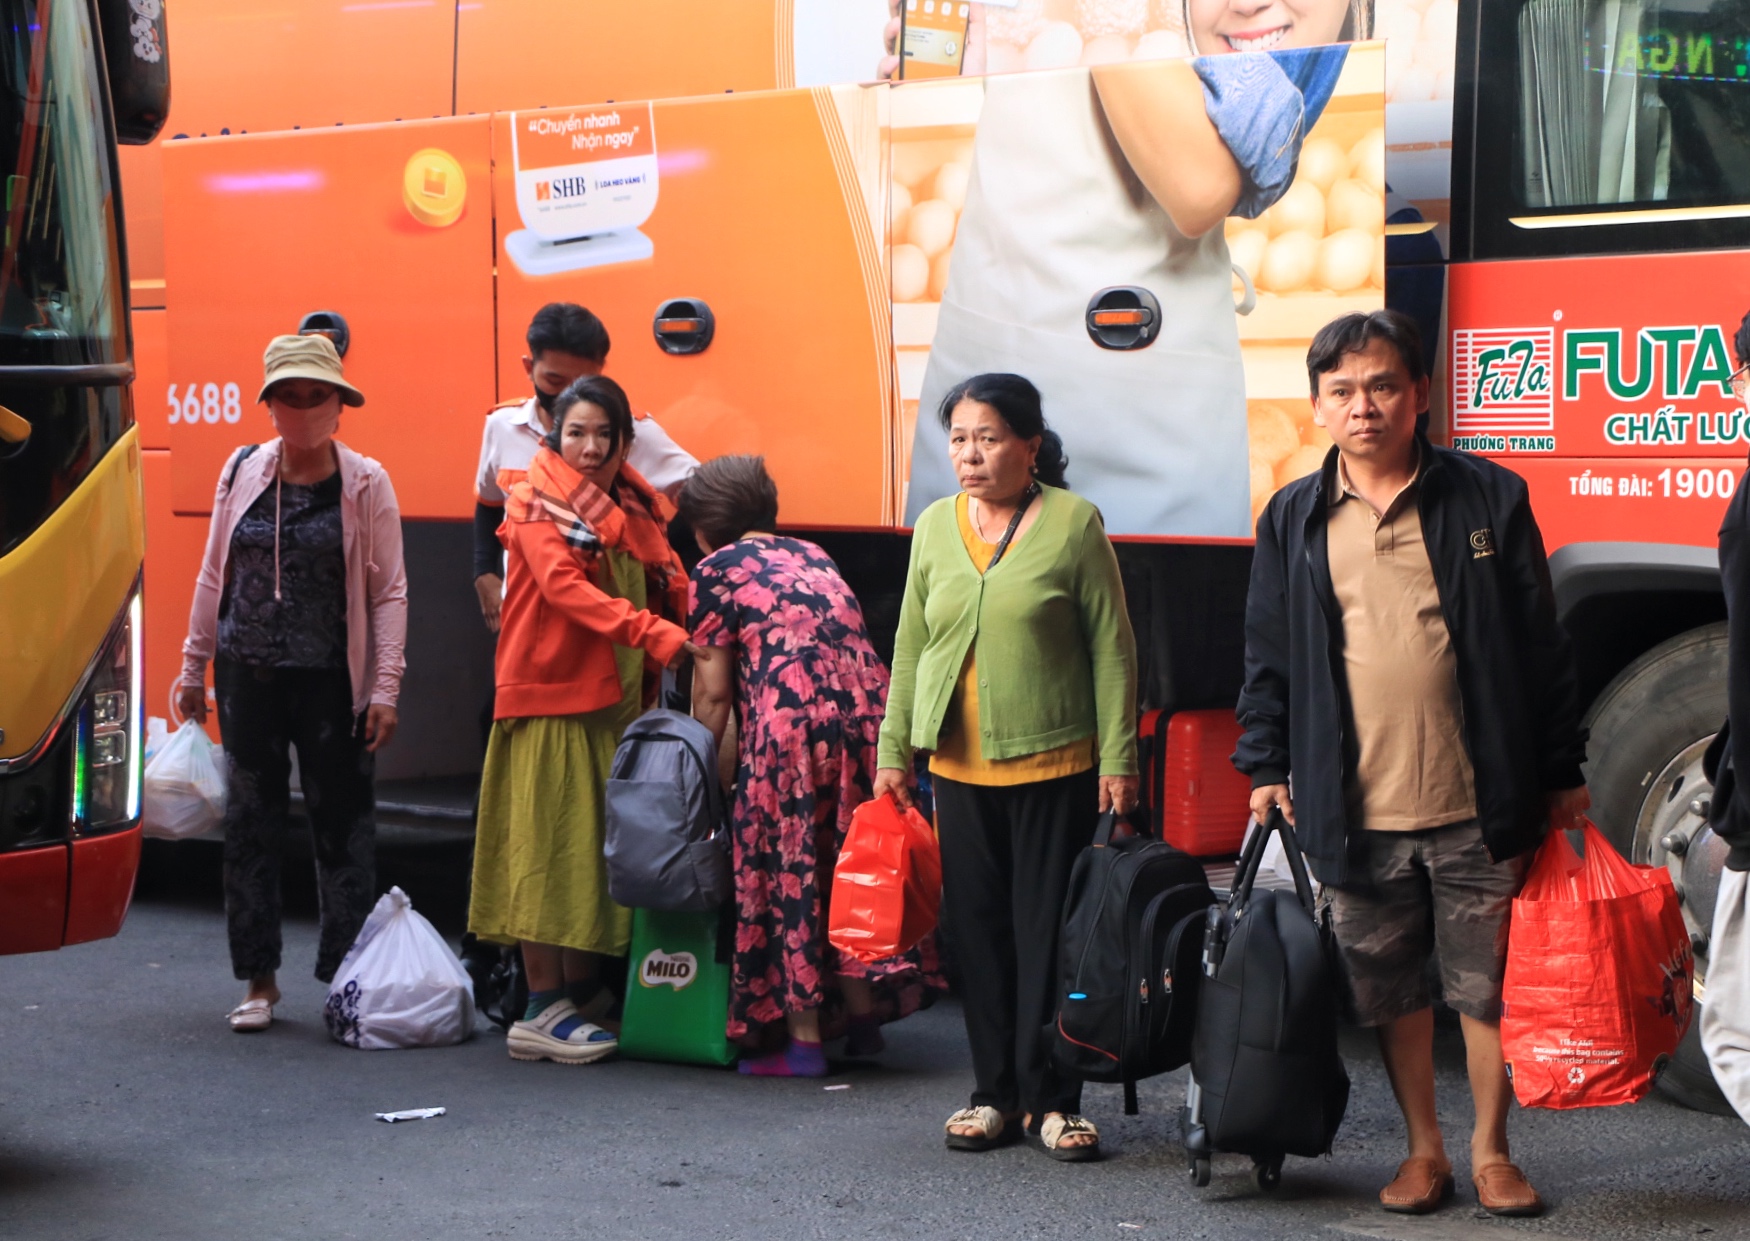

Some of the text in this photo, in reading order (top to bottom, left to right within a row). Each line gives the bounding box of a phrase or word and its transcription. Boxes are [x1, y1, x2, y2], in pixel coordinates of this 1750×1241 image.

[584, 111, 620, 129] nhanh
[572, 132, 603, 152] Nhận
[552, 176, 586, 199] SHB
[1563, 325, 1737, 401] FUTA
[167, 382, 242, 424] 6688
[1605, 405, 1694, 445] CHẤT
[1453, 434, 1555, 451] PHƯƠNG TRANG
[1569, 468, 1735, 498] TỔNG ĐÀI: 1900
[647, 960, 690, 978] MILO
[1532, 1046, 1560, 1055] because
[1561, 1047, 1575, 1056] this
[1575, 1048, 1591, 1057] bag
[1553, 1057, 1585, 1065] recycled
